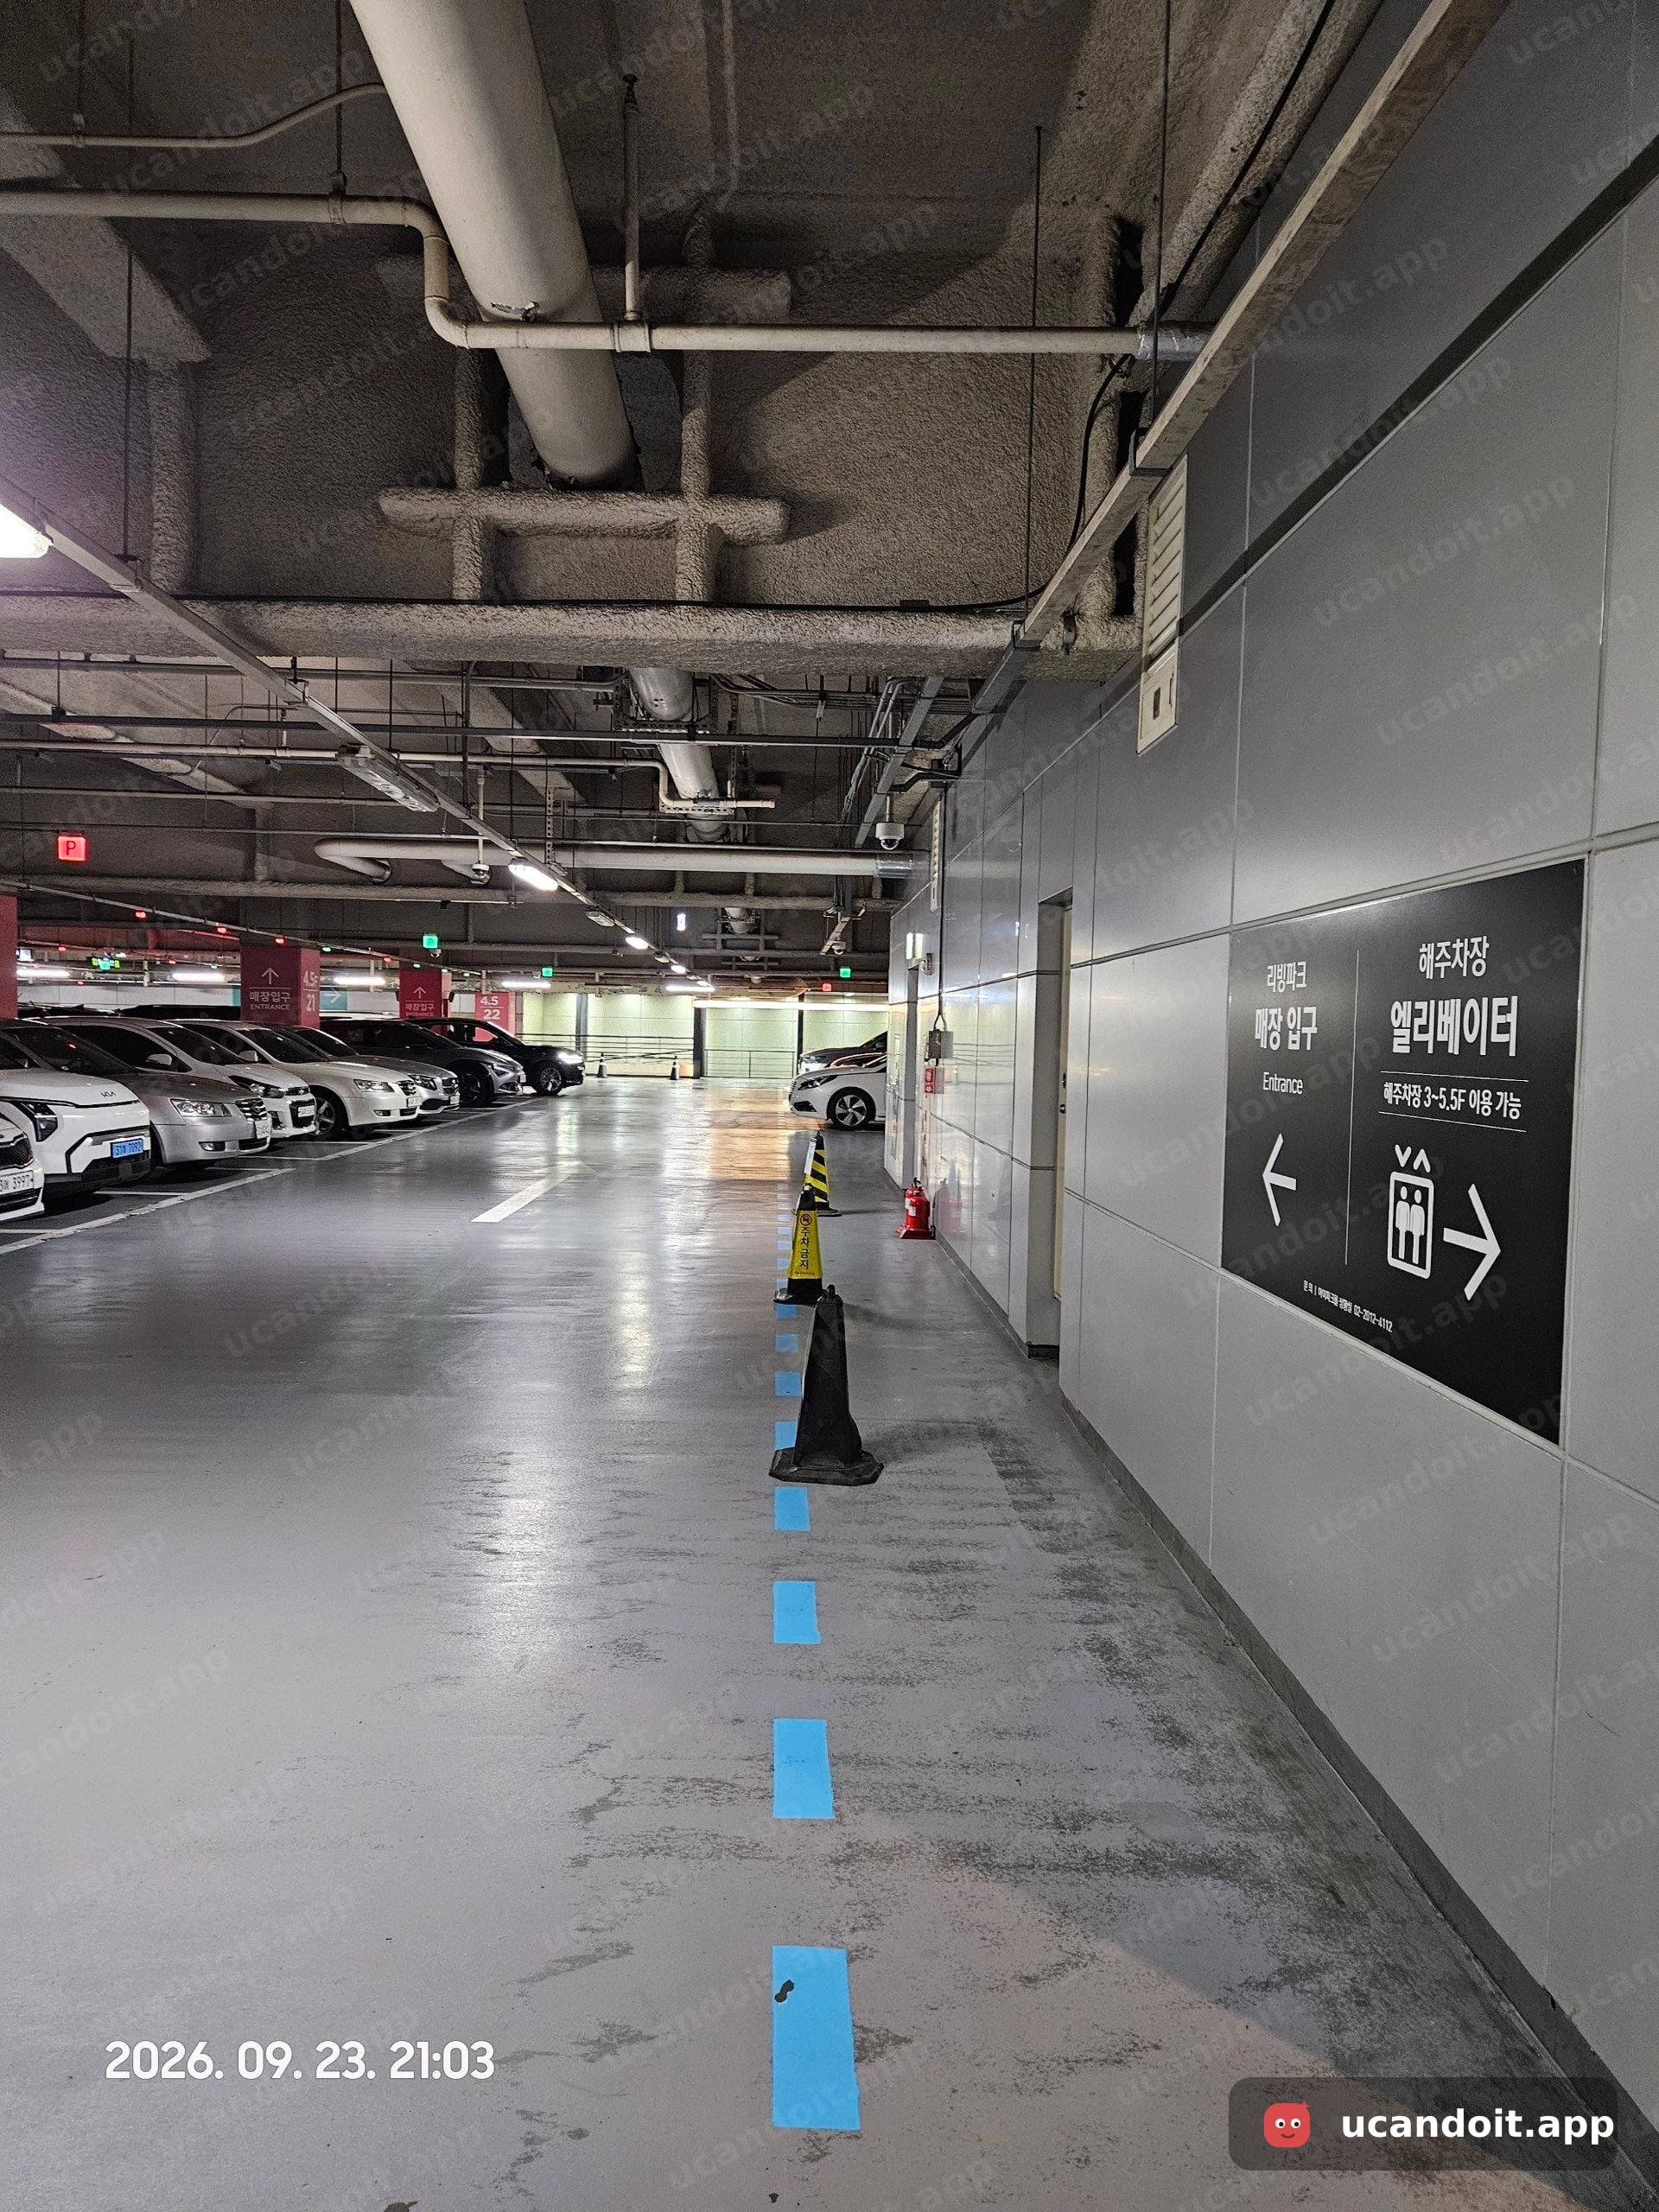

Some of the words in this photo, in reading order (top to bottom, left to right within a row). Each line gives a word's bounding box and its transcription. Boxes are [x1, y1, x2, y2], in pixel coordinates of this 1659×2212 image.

[66, 840, 76, 855] P
[1419, 936, 1489, 979] 해주차장
[1267, 961, 1306, 993] 리빙파크
[250, 991, 291, 1002] 매장입구
[306, 993, 315, 1012] 21
[483, 1008, 500, 1020] 22
[1255, 1007, 1283, 1051] 매장
[1287, 1006, 1318, 1051] 입구
[1390, 995, 1518, 1057] 엘리베이터
[1263, 1071, 1303, 1095] Entrance
[1383, 1082, 1422, 1109] 해주차장
[1423, 1086, 1466, 1111] 3~5.5F
[1469, 1090, 1492, 1116] 이용
[1496, 1090, 1522, 1120] 가능
[12, 1175, 29, 1190] 3997
[800, 1227, 810, 1269] 주차금지
[1303, 1280, 1313, 1294] 문의
[1353, 1305, 1393, 1332] 02-2012-4112
